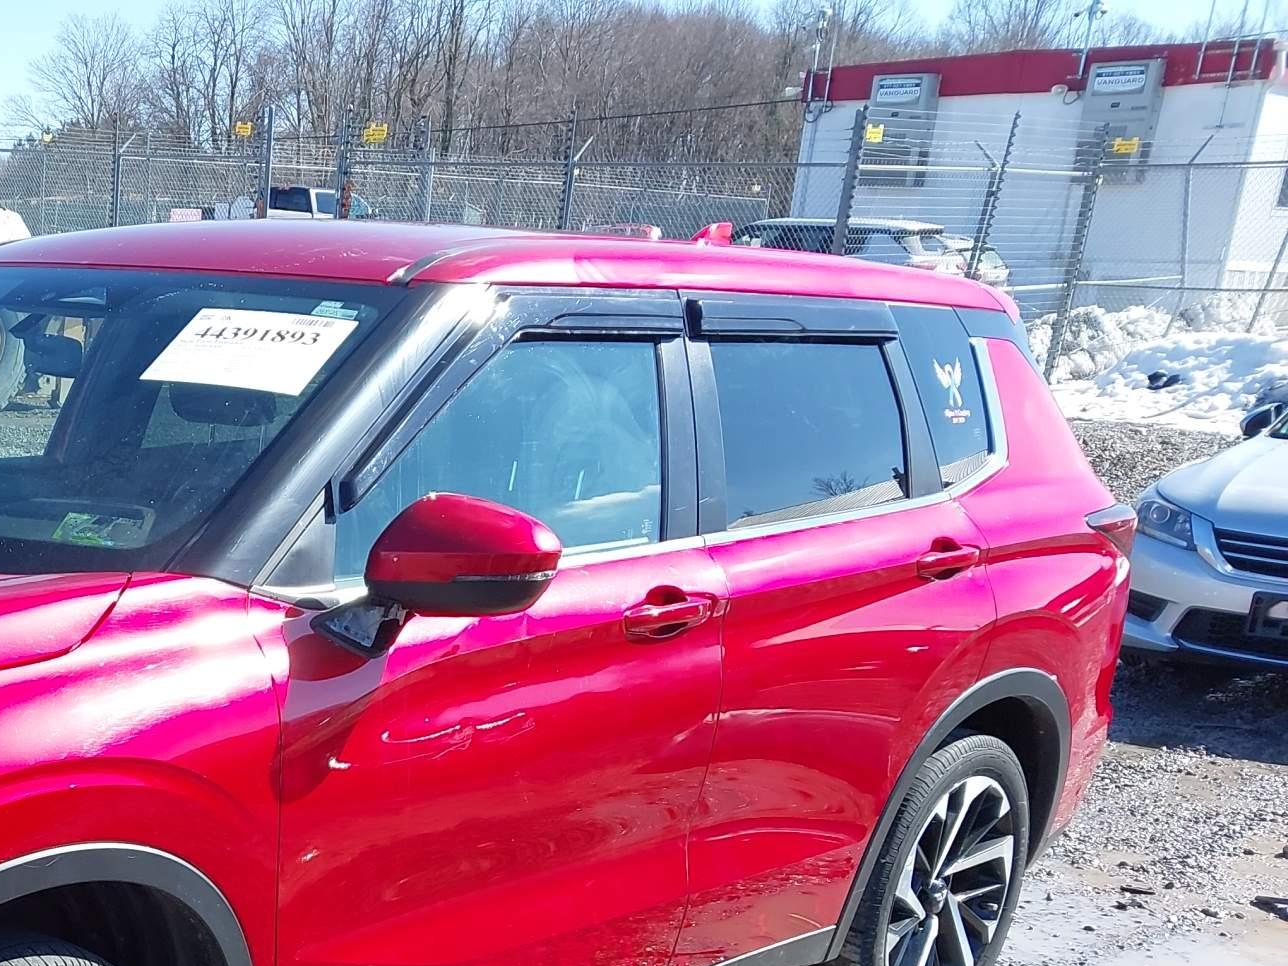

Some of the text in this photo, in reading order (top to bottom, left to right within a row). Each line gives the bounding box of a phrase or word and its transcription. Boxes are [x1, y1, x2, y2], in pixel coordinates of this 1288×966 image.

[1096, 77, 1144, 85] VANGUARD
[879, 89, 918, 97] VANGUARD
[194, 325, 321, 346] 44391893
